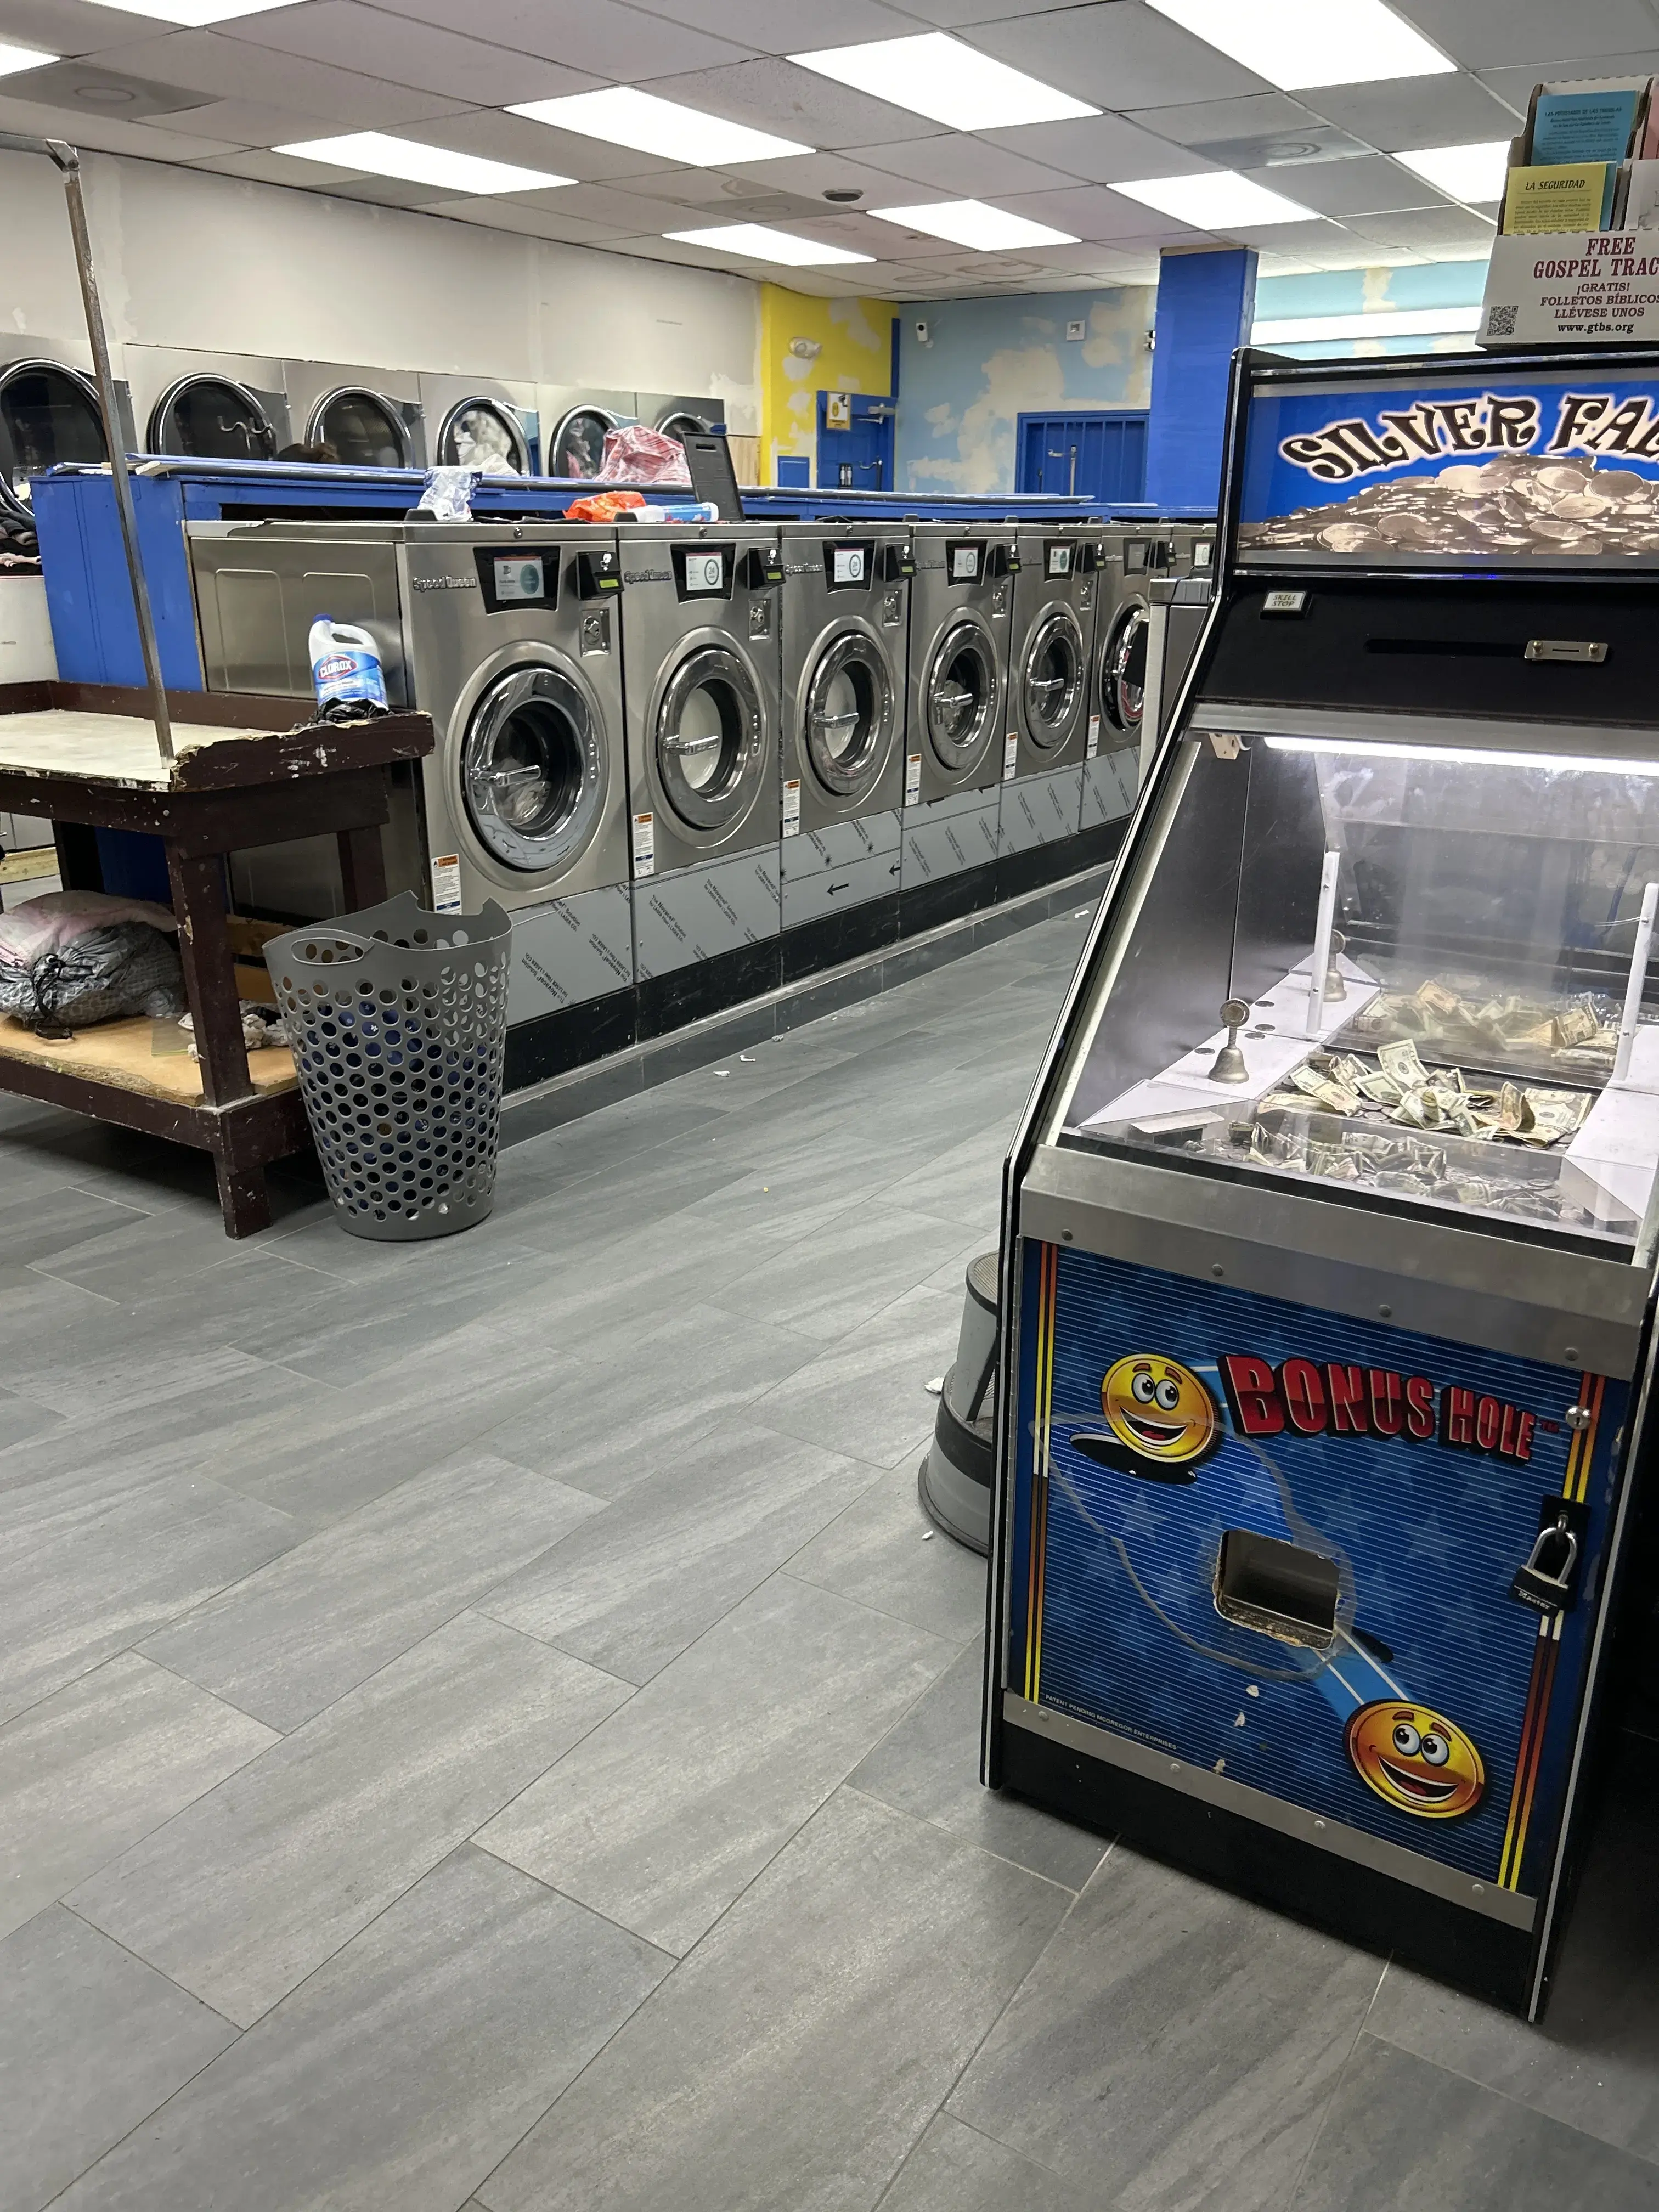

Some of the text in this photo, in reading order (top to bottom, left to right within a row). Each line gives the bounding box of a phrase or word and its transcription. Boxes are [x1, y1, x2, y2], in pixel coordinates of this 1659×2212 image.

[1525, 179, 1585, 190] LA SEGURIDAD
[1585, 237, 1636, 256] FREE
[1533, 259, 1601, 279] GOSPEL
[1577, 282, 1630, 295] ¡GRATIS!
[1541, 296, 1602, 306] FOLLETOS
[1554, 306, 1645, 318] LLÉVESE UNOS
[1558, 322, 1634, 334] www.gtbs.org
[1282, 395, 1537, 479] SILVER
[320, 660, 352, 677] CLOROX
[1217, 1353, 1438, 1438] BONUS
[1438, 1385, 1536, 1467] HOLE
[1045, 1694, 1177, 1750] PATENT PENDING MCGREGOR ENTERPRISES
